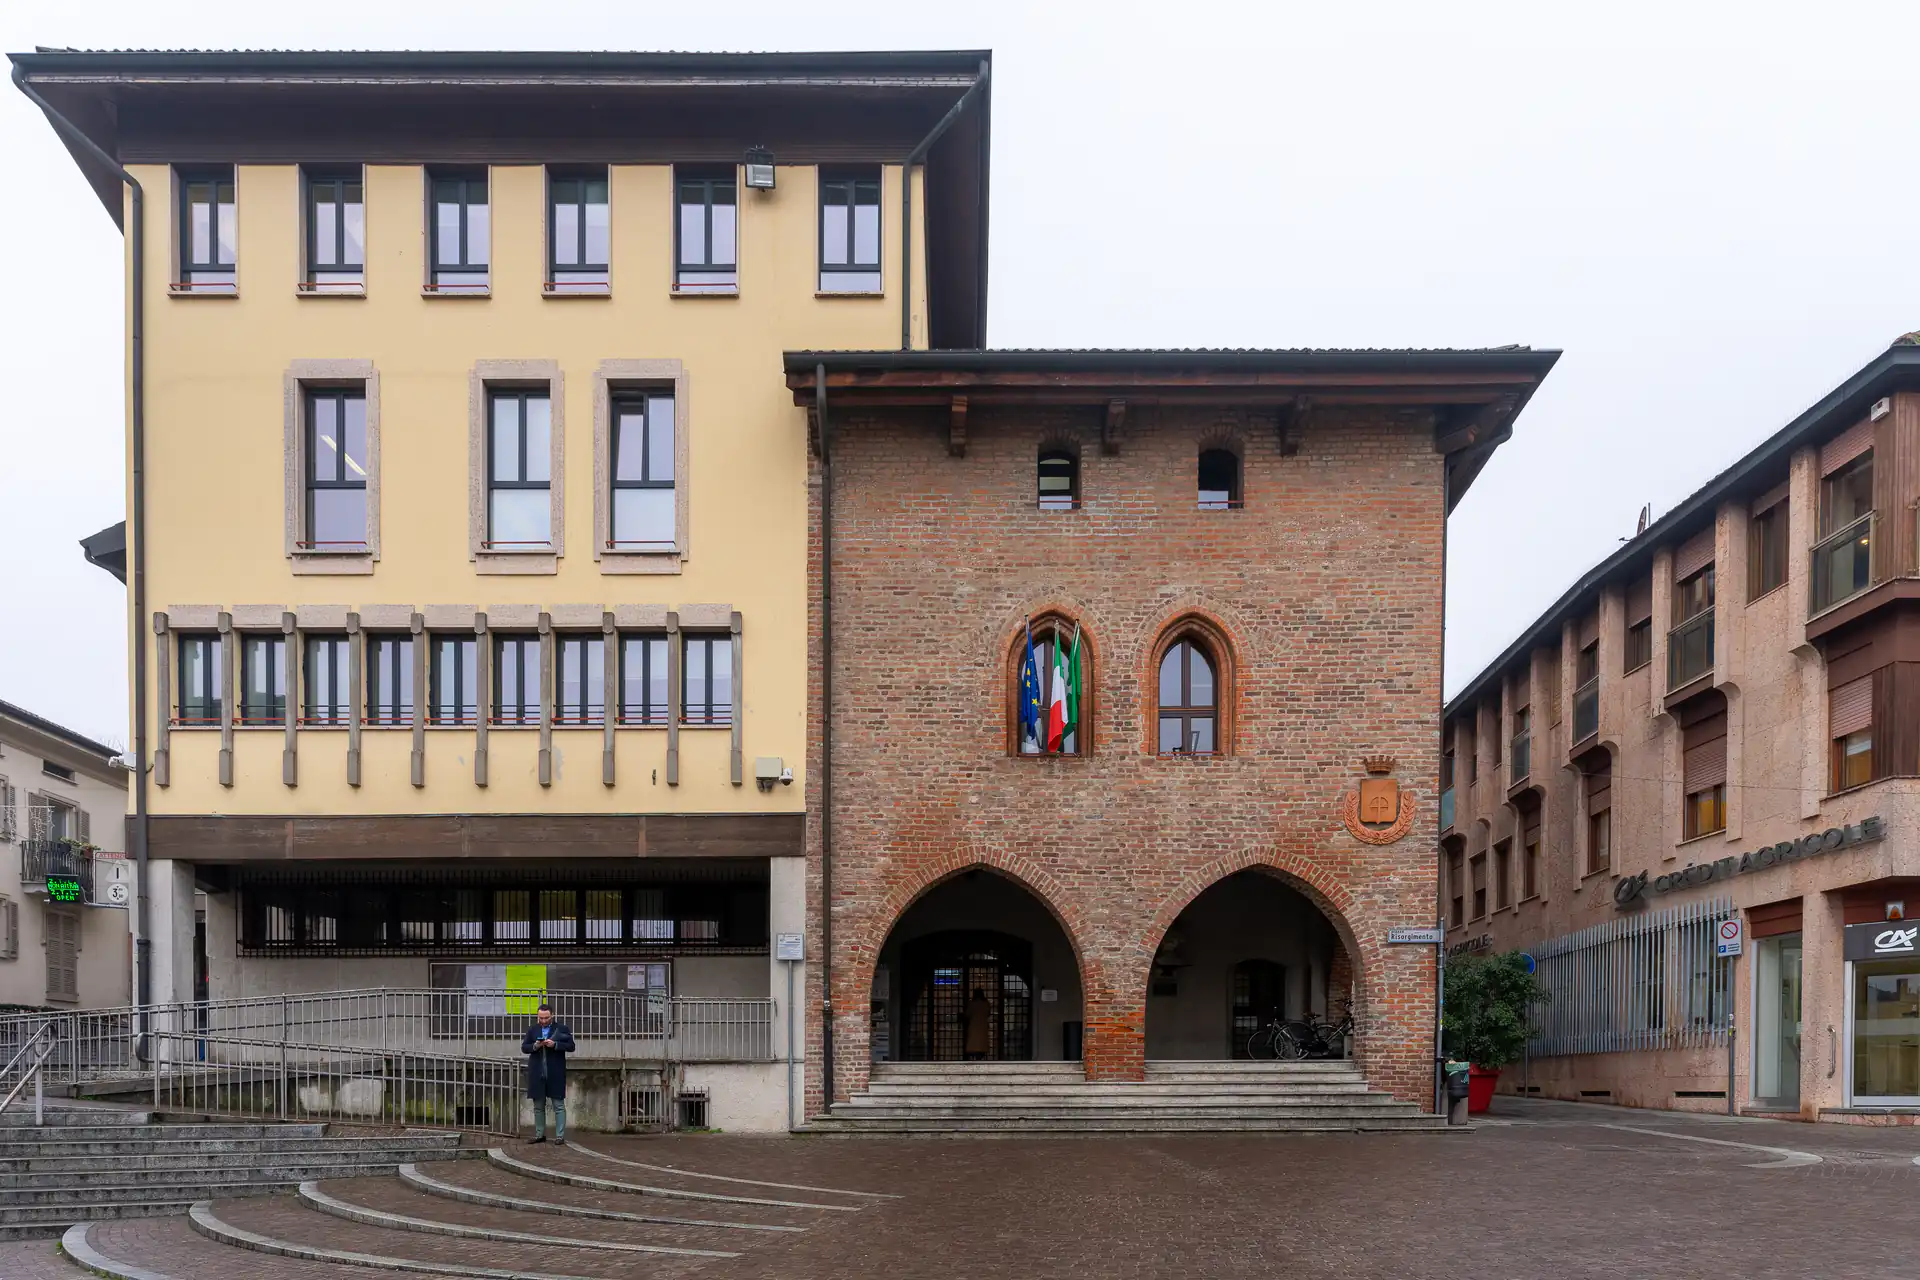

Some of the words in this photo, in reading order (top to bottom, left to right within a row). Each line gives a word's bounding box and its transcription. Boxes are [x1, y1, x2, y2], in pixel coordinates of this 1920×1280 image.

[1653, 855, 1735, 894] CRÉDIT
[1738, 815, 1881, 873] AGRICOLE
[1391, 933, 1434, 942] Risorgimento
